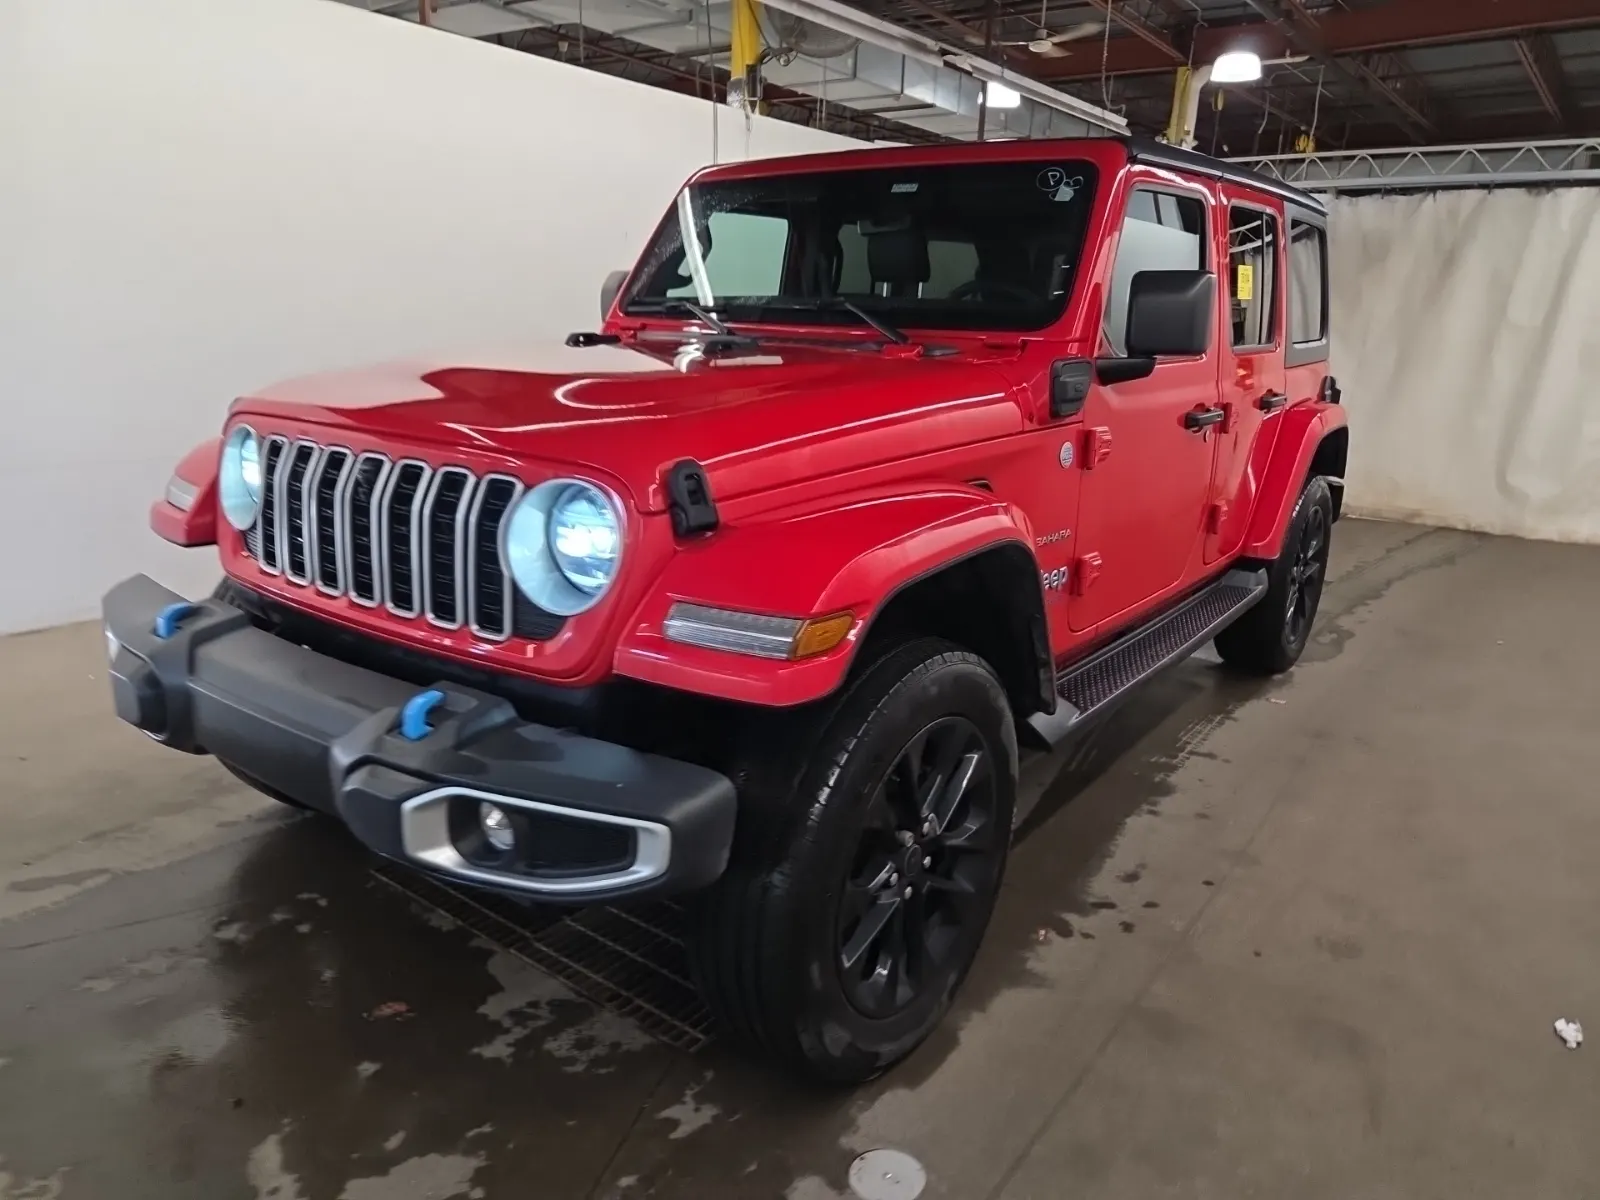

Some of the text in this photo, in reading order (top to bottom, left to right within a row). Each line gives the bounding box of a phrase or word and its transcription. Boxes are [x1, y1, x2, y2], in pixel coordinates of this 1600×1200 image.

[1047, 171, 1060, 186] P
[1036, 529, 1071, 546] SAHARA
[1040, 566, 1068, 590] eep
